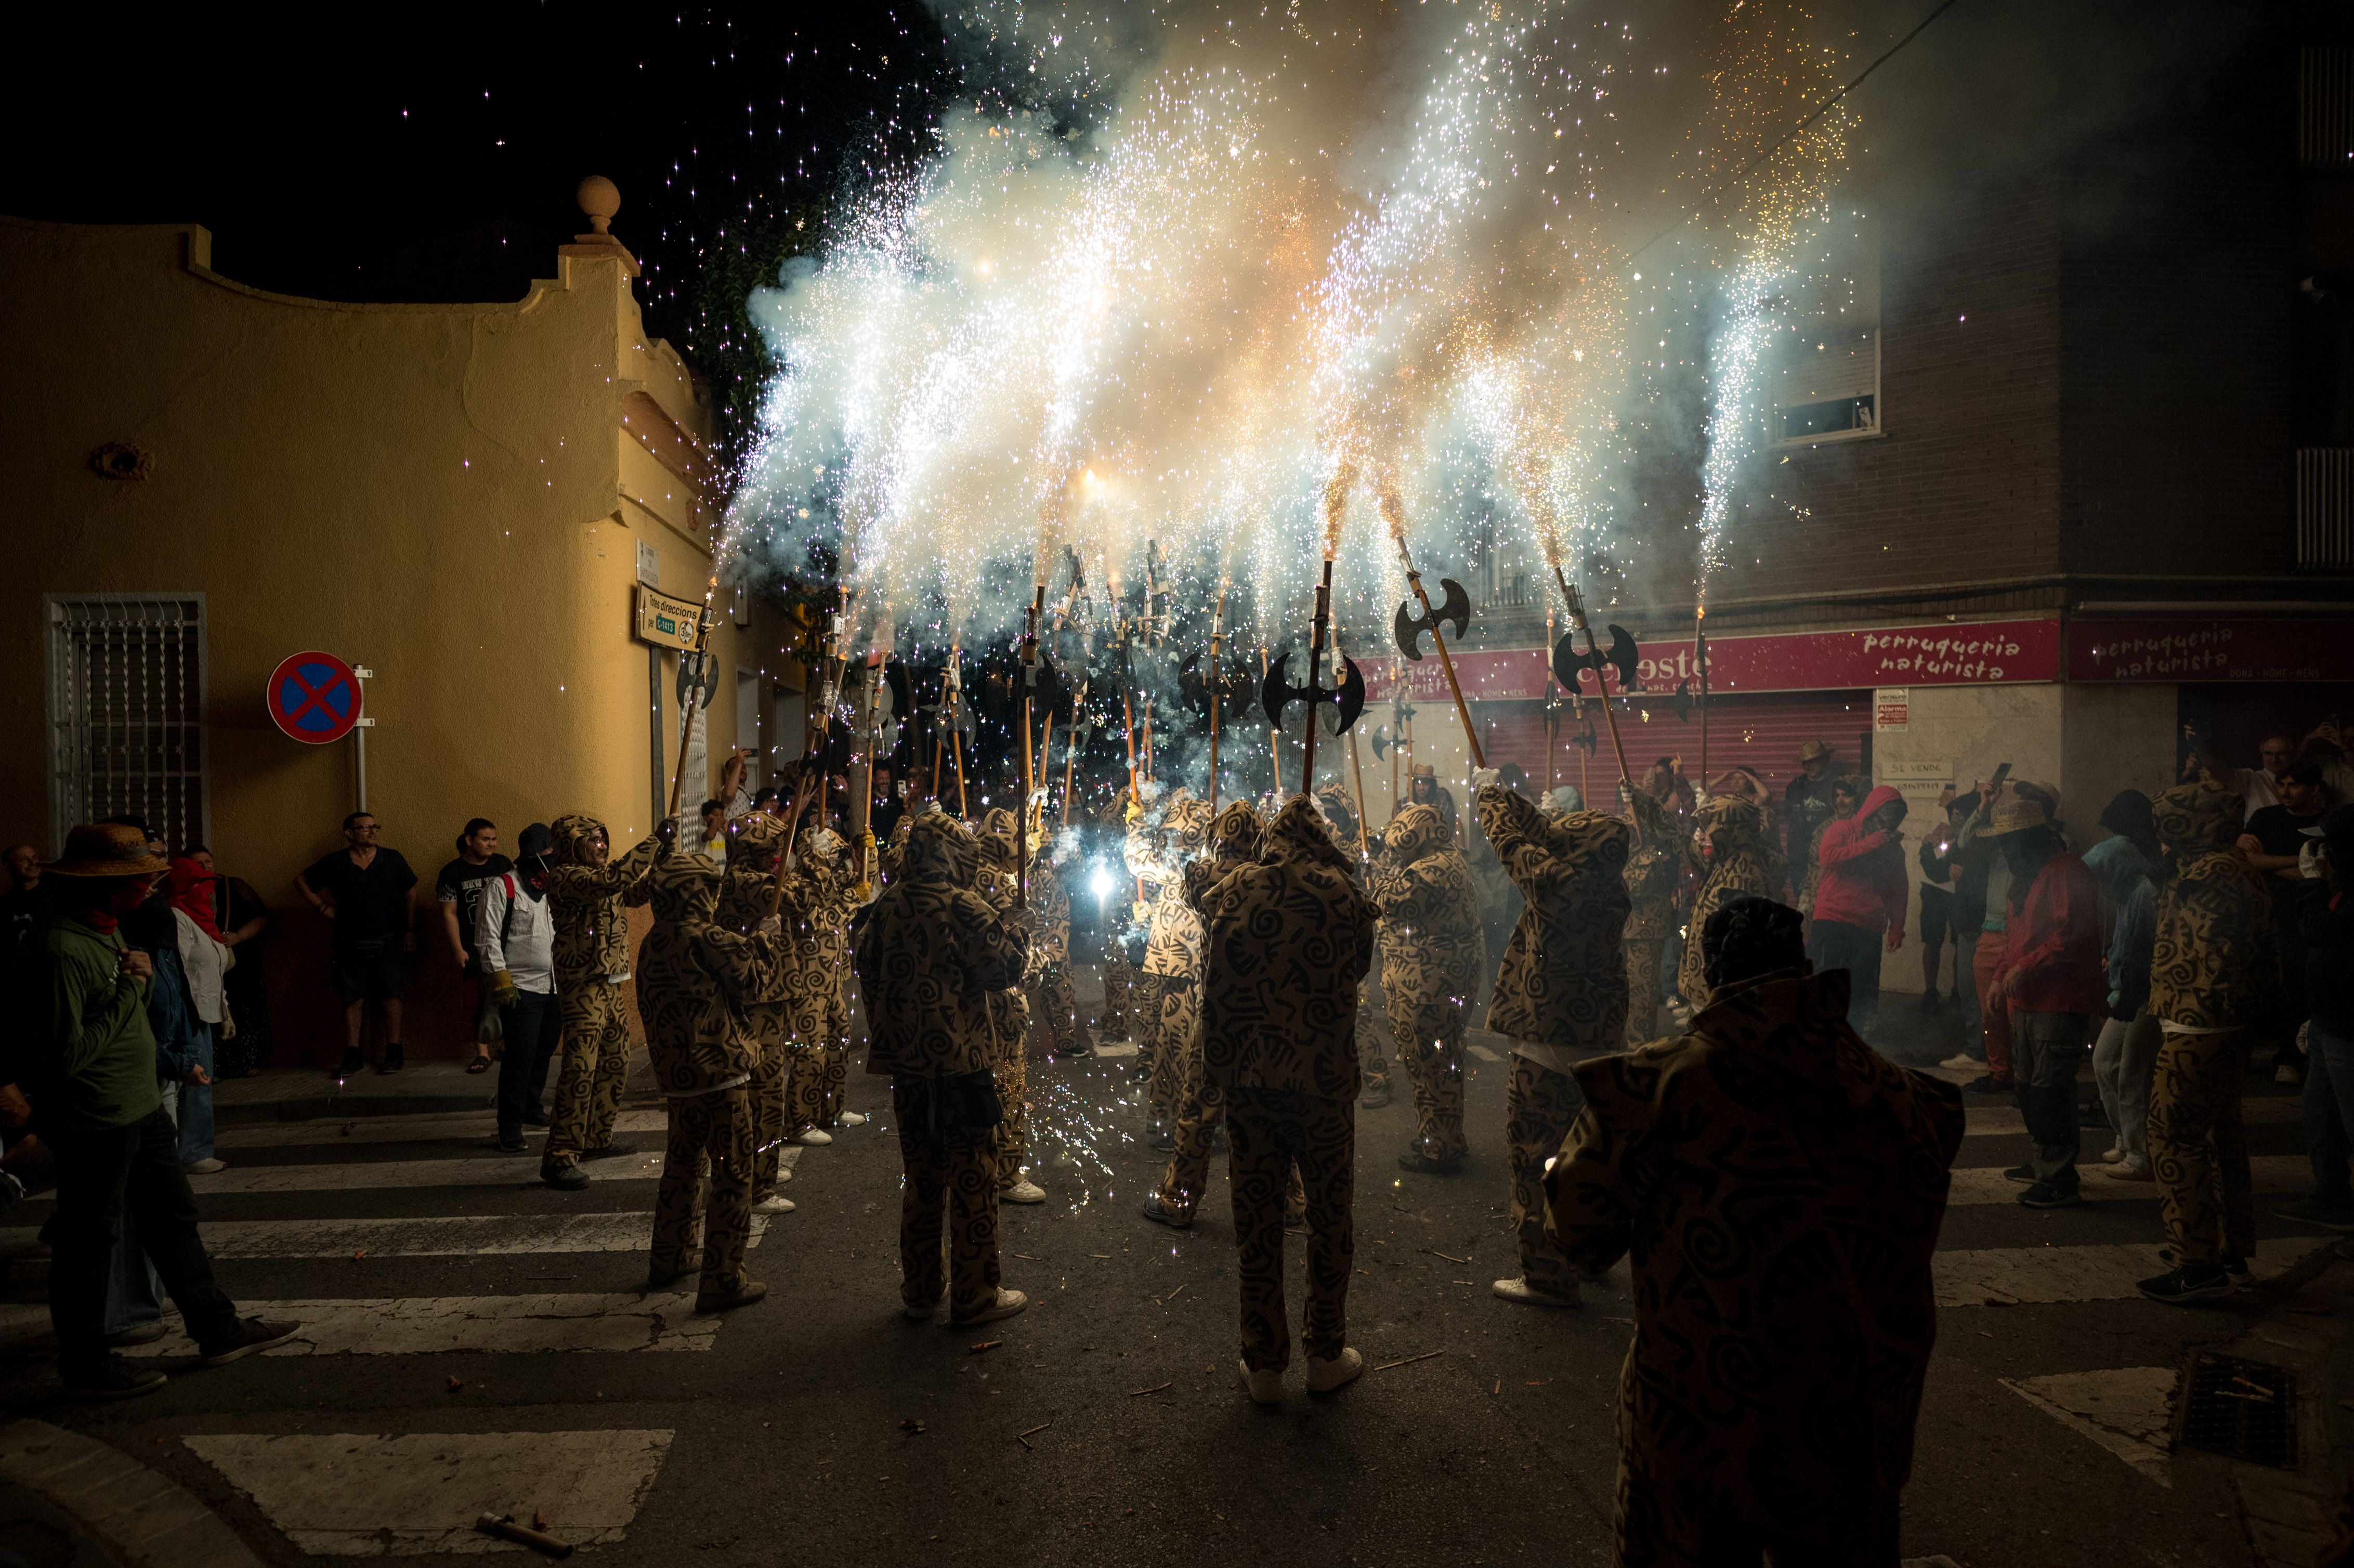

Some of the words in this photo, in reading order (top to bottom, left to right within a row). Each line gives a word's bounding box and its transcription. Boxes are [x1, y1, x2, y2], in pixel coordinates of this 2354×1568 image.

[649, 594, 660, 609] Totes
[661, 600, 697, 619] direccions
[657, 619, 673, 633] C-1413
[1863, 633, 2021, 660] perruqueria
[2094, 622, 2233, 665] perruqueria
[1880, 653, 2004, 680] naturista
[2115, 649, 2228, 678] naturista
[2229, 668, 2254, 678] DONA
[2263, 668, 2288, 678] HOME
[2295, 668, 2320, 678] NENS
[1482, 689, 1502, 698] HOME
[1508, 689, 1527, 697] NENS
[1890, 764, 1905, 773] SE
[1910, 764, 1942, 772] VENDE
[461, 878, 482, 891] NEW
